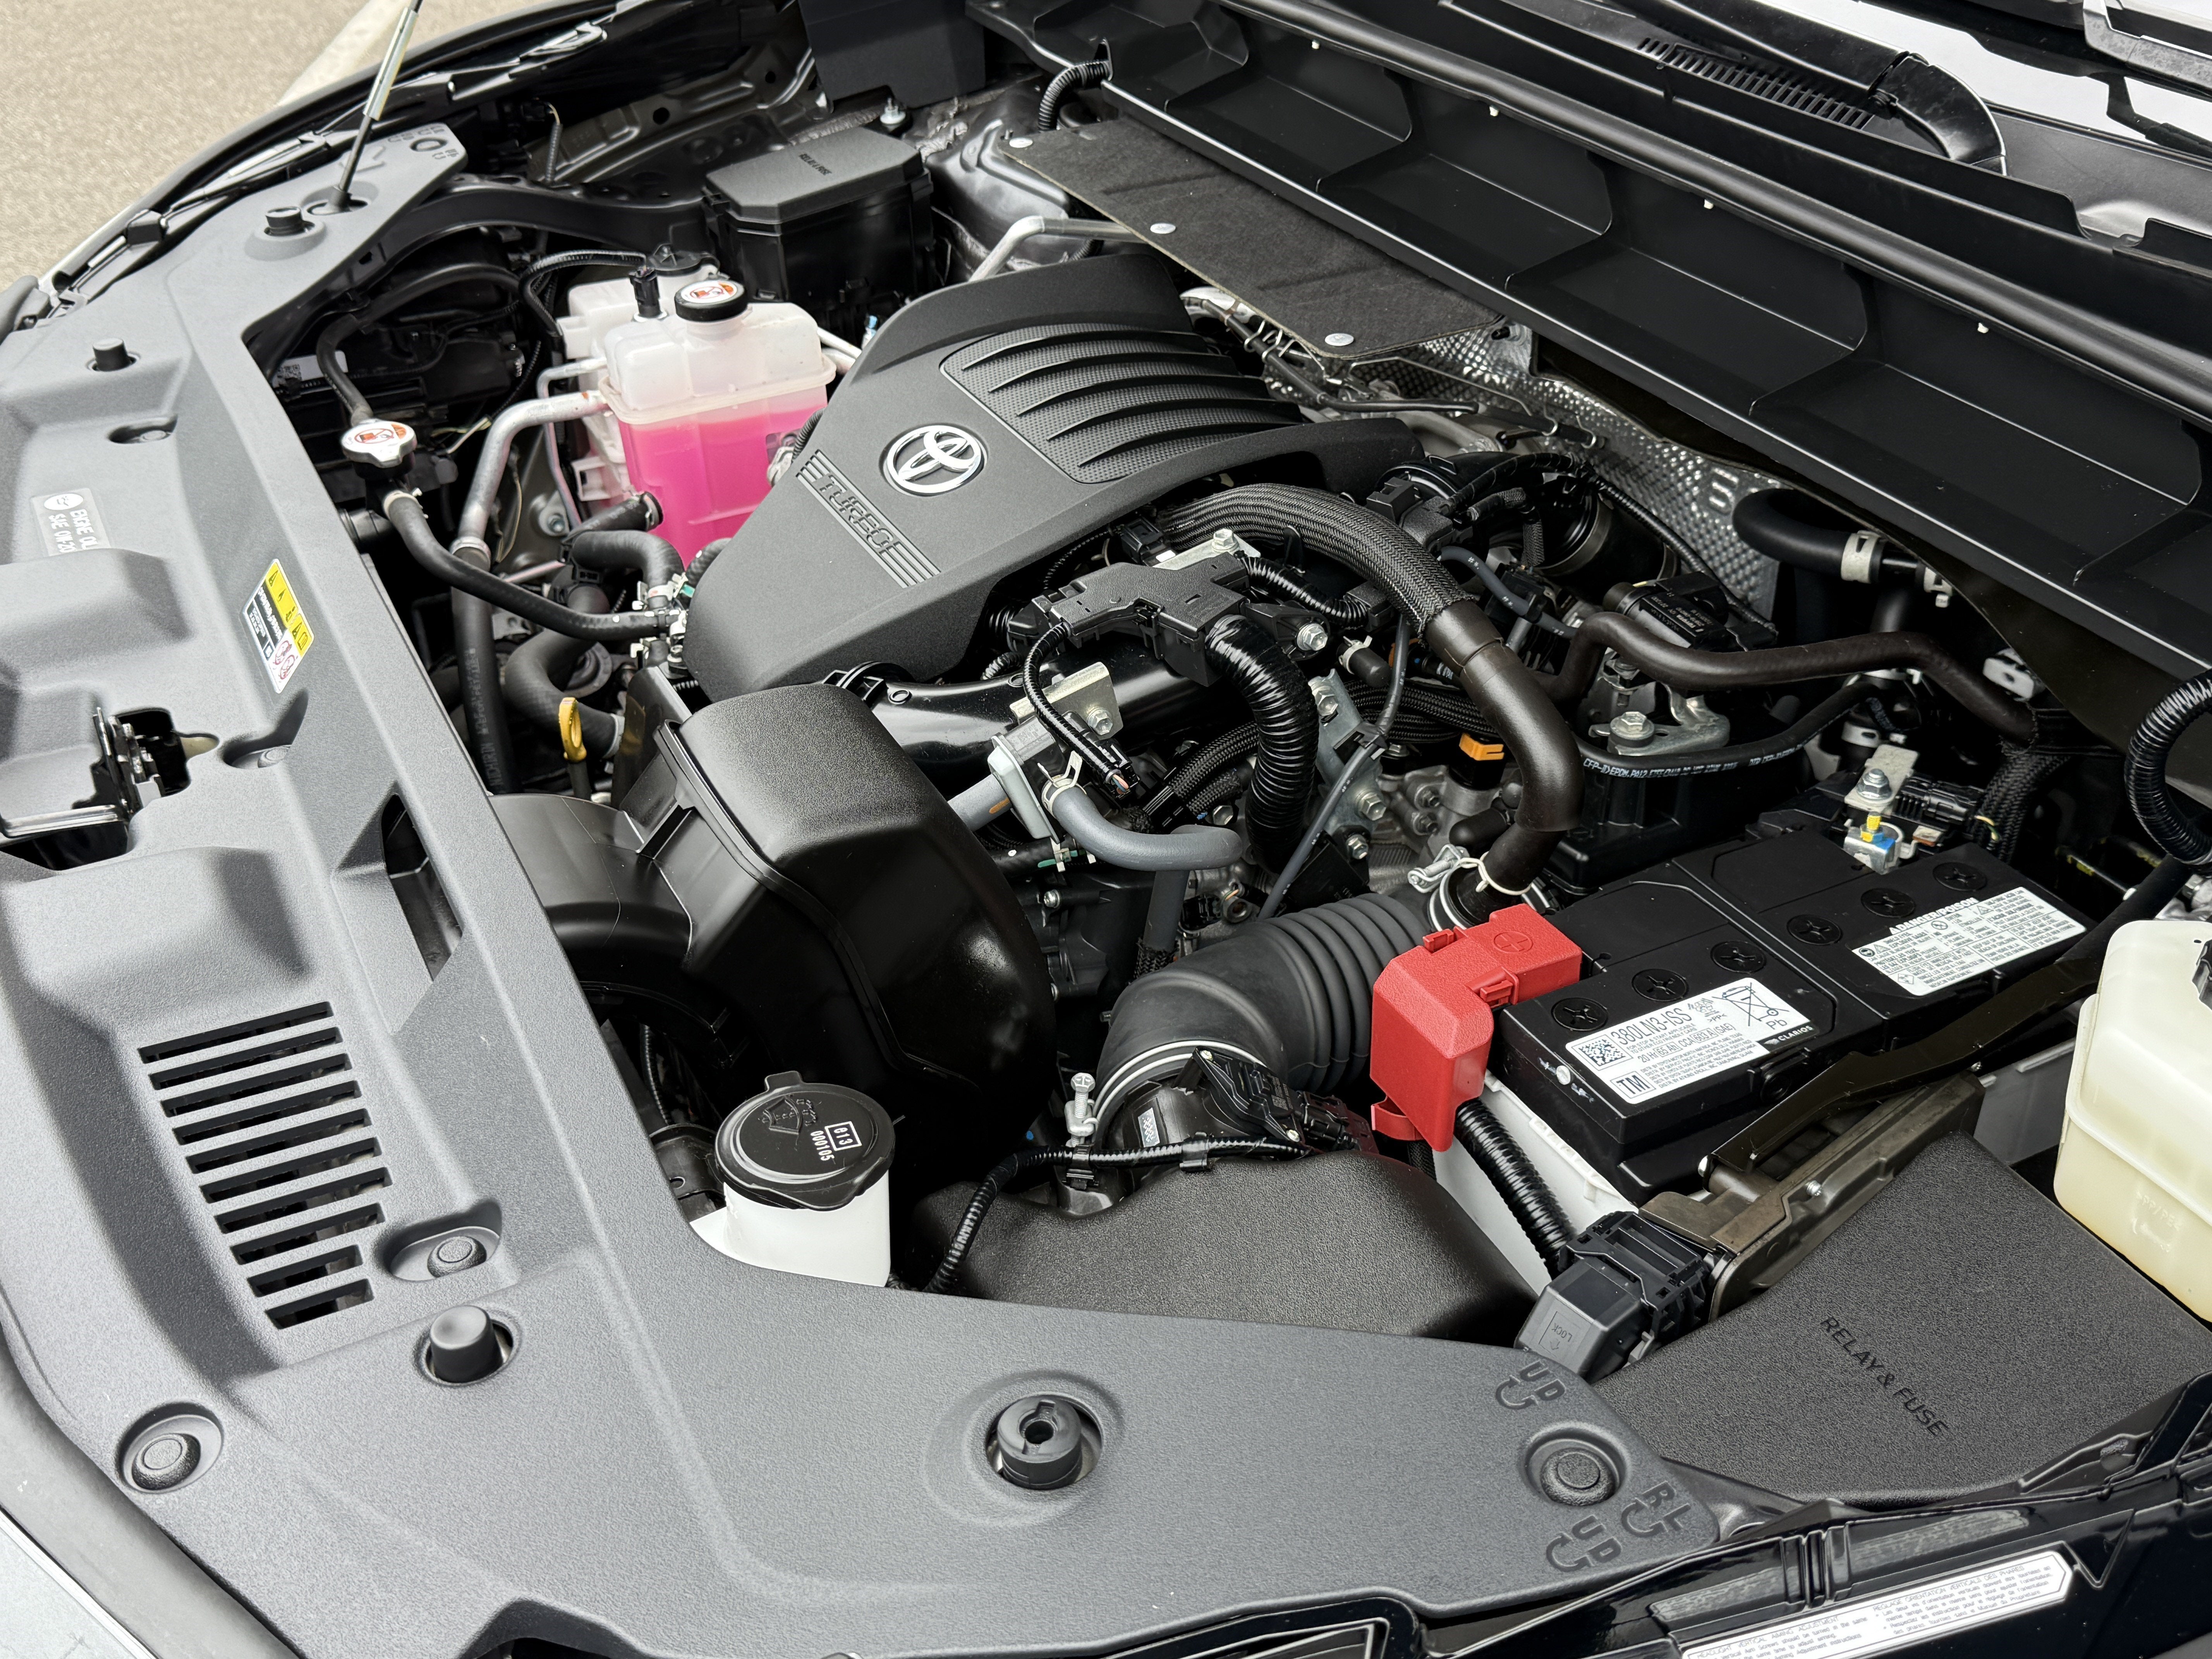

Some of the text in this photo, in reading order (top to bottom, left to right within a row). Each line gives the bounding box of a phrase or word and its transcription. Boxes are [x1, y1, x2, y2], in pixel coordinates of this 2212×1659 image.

[49, 514, 69, 529] SAE
[819, 474, 894, 549] TURBO
[1894, 896, 1980, 931] DANGER/POISON
[1609, 1007, 1693, 1045] 380LN3-ISS
[1765, 1017, 1788, 1029] Pb
[1776, 1025, 1814, 1041] CLARIOS
[1636, 1054, 1651, 1063] 20
[1646, 1051, 1659, 1059] Hr
[1655, 1047, 1669, 1055] 65
[1664, 1043, 1679, 1052] Ah
[1677, 1037, 1697, 1047] CCA
[1692, 1032, 1710, 1042] 603
[1712, 1022, 1737, 1035] (SAE)
[1615, 1074, 1650, 1095] TM
[811, 1130, 835, 1161] 000105
[834, 1127, 853, 1145] e13
[1551, 1322, 1573, 1342] LOCK
[1820, 1317, 1950, 1437] RELAY & FUSE
